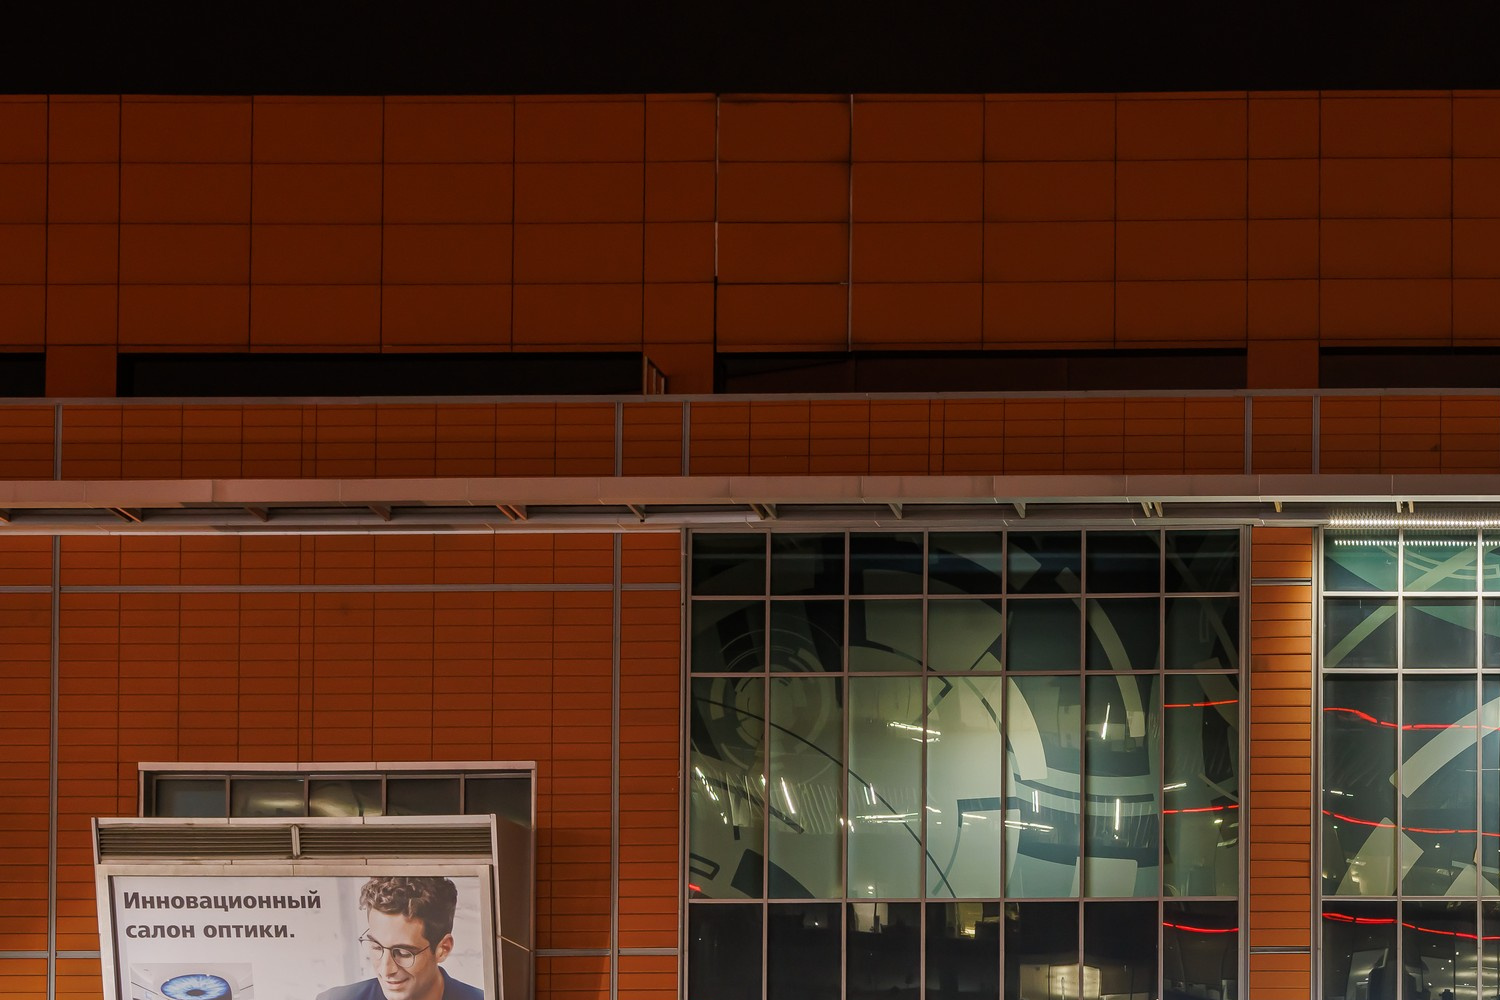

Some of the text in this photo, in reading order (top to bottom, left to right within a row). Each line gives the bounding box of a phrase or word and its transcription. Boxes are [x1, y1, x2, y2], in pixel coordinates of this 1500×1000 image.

[123, 890, 321, 913] Инновационный
[125, 922, 295, 939] салон оптики.
